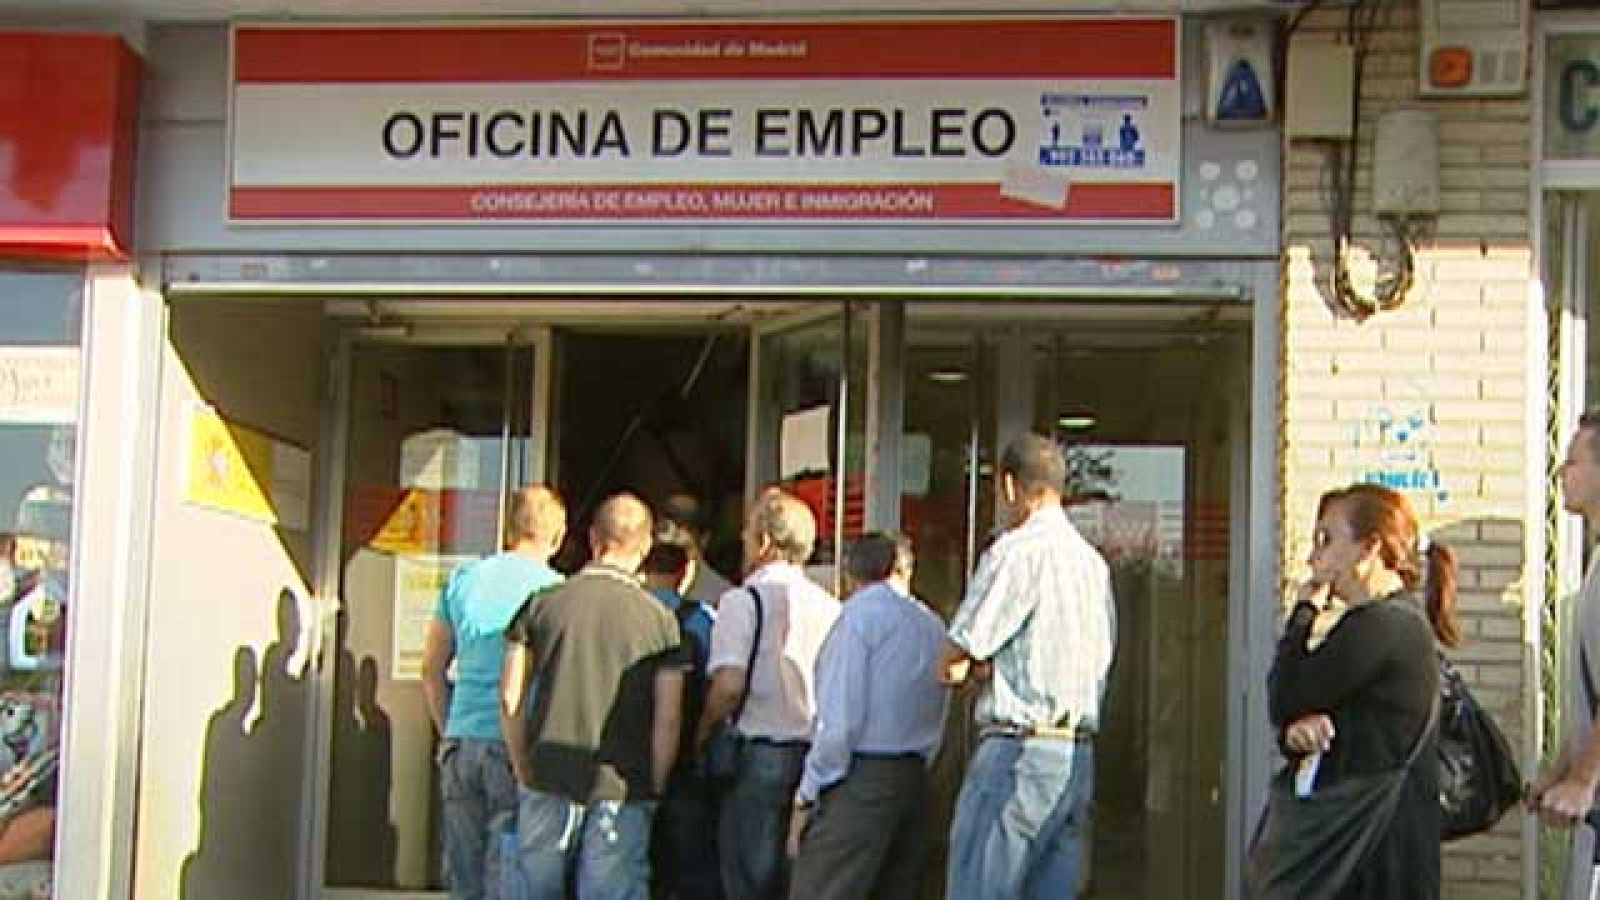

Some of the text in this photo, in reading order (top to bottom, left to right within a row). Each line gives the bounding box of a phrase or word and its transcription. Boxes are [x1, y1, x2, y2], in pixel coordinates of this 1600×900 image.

[629, 40, 807, 58] Comunidad de Madrid
[382, 106, 1016, 158] OFICINA DE EMPLEO
[593, 192, 621, 212] DE
[624, 192, 707, 213] EMPLEO,
[711, 191, 781, 212] MUJER
[784, 191, 798, 211] E
[801, 188, 934, 212] INMIGRACIÓN
